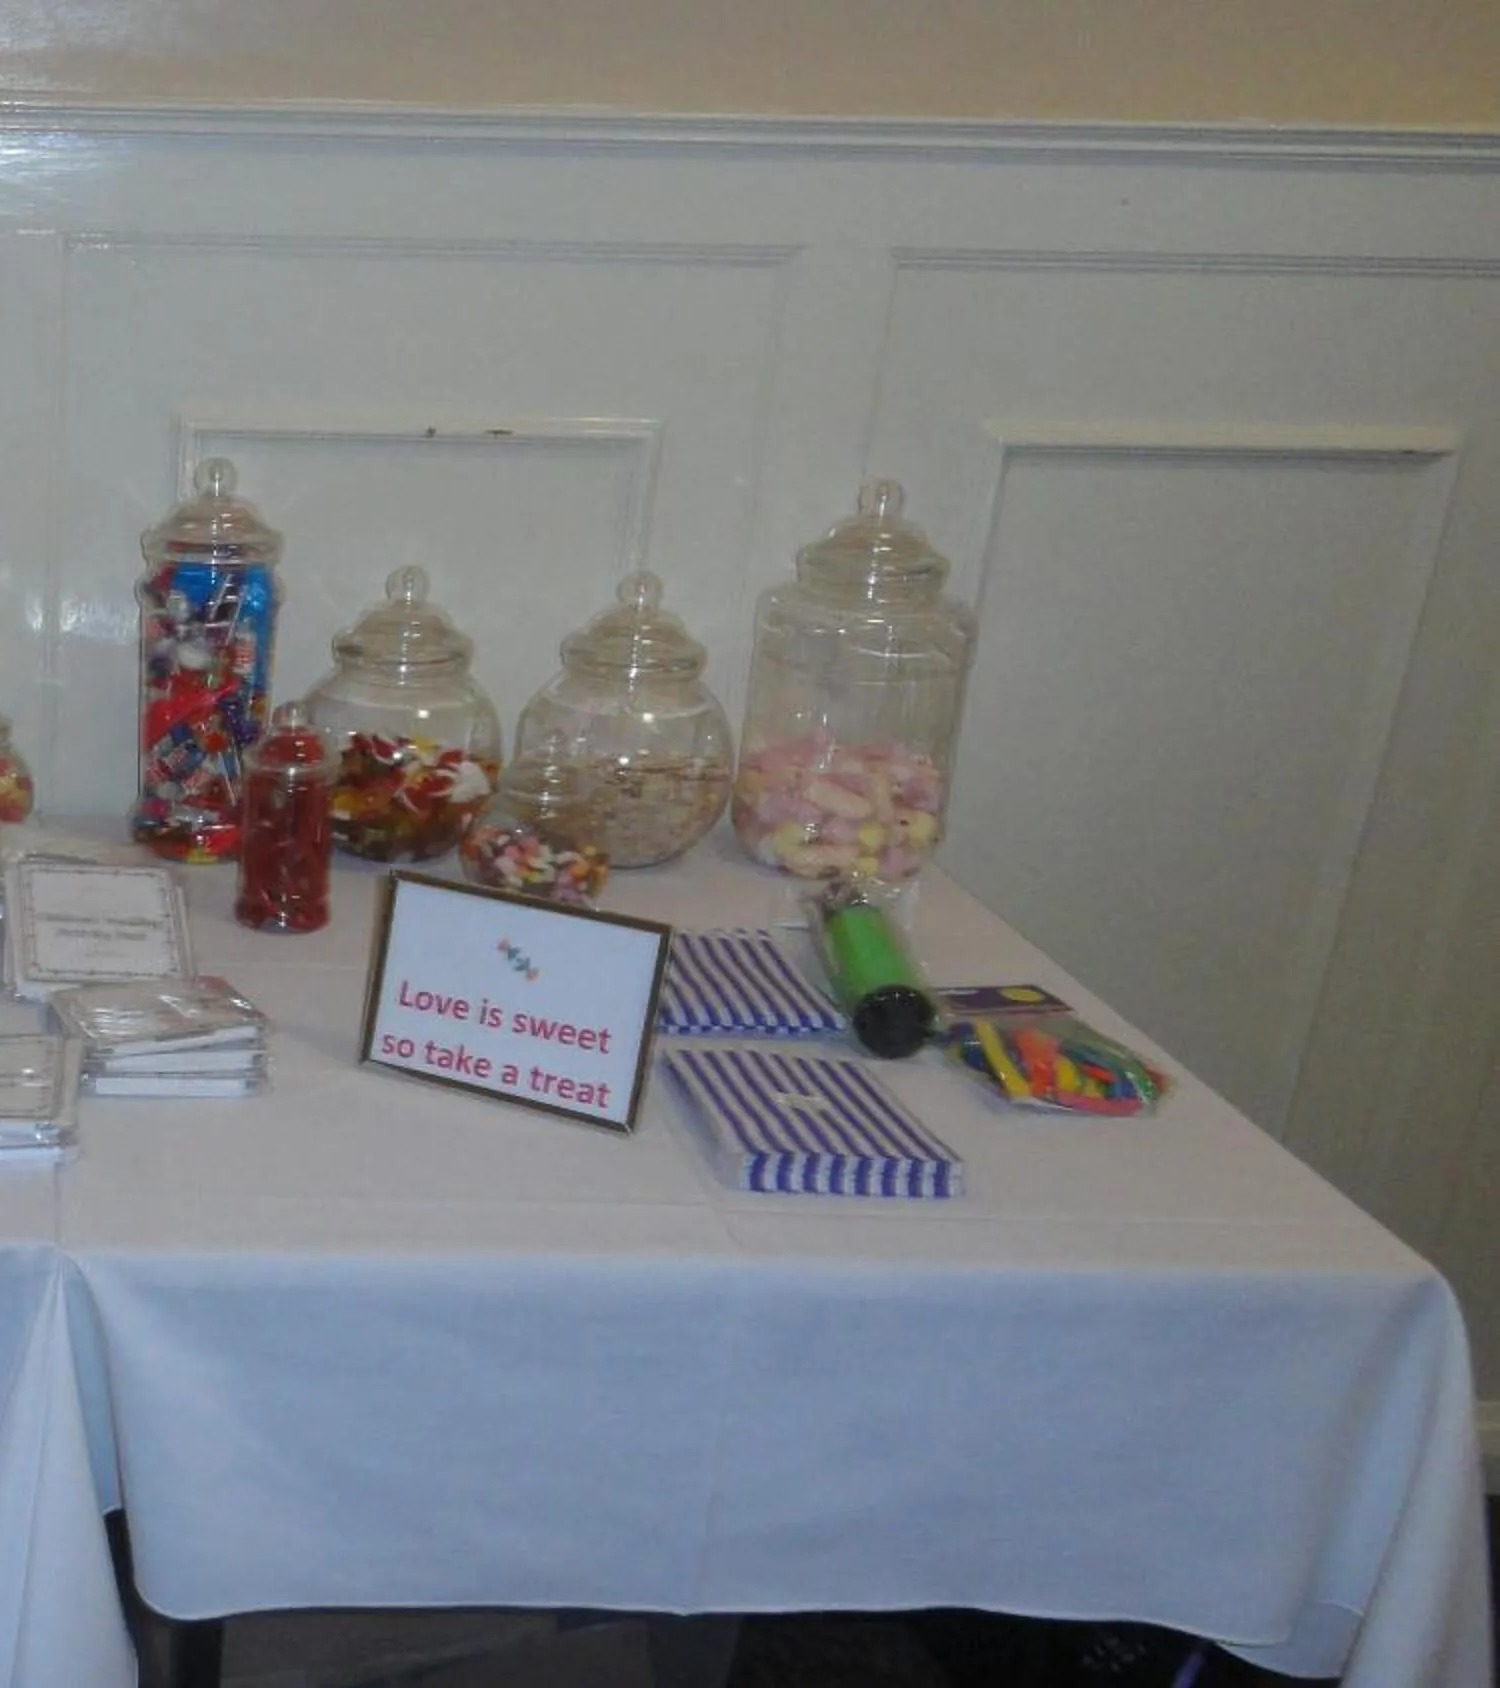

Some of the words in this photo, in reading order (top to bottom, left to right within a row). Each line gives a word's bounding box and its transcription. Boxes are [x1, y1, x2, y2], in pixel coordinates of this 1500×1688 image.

[397, 981, 469, 1021] Love
[478, 998, 504, 1028] is
[511, 1012, 612, 1054] sweet
[382, 1033, 415, 1058] so
[422, 1040, 492, 1078] take
[501, 1065, 519, 1087] a
[529, 1066, 612, 1109] treat
